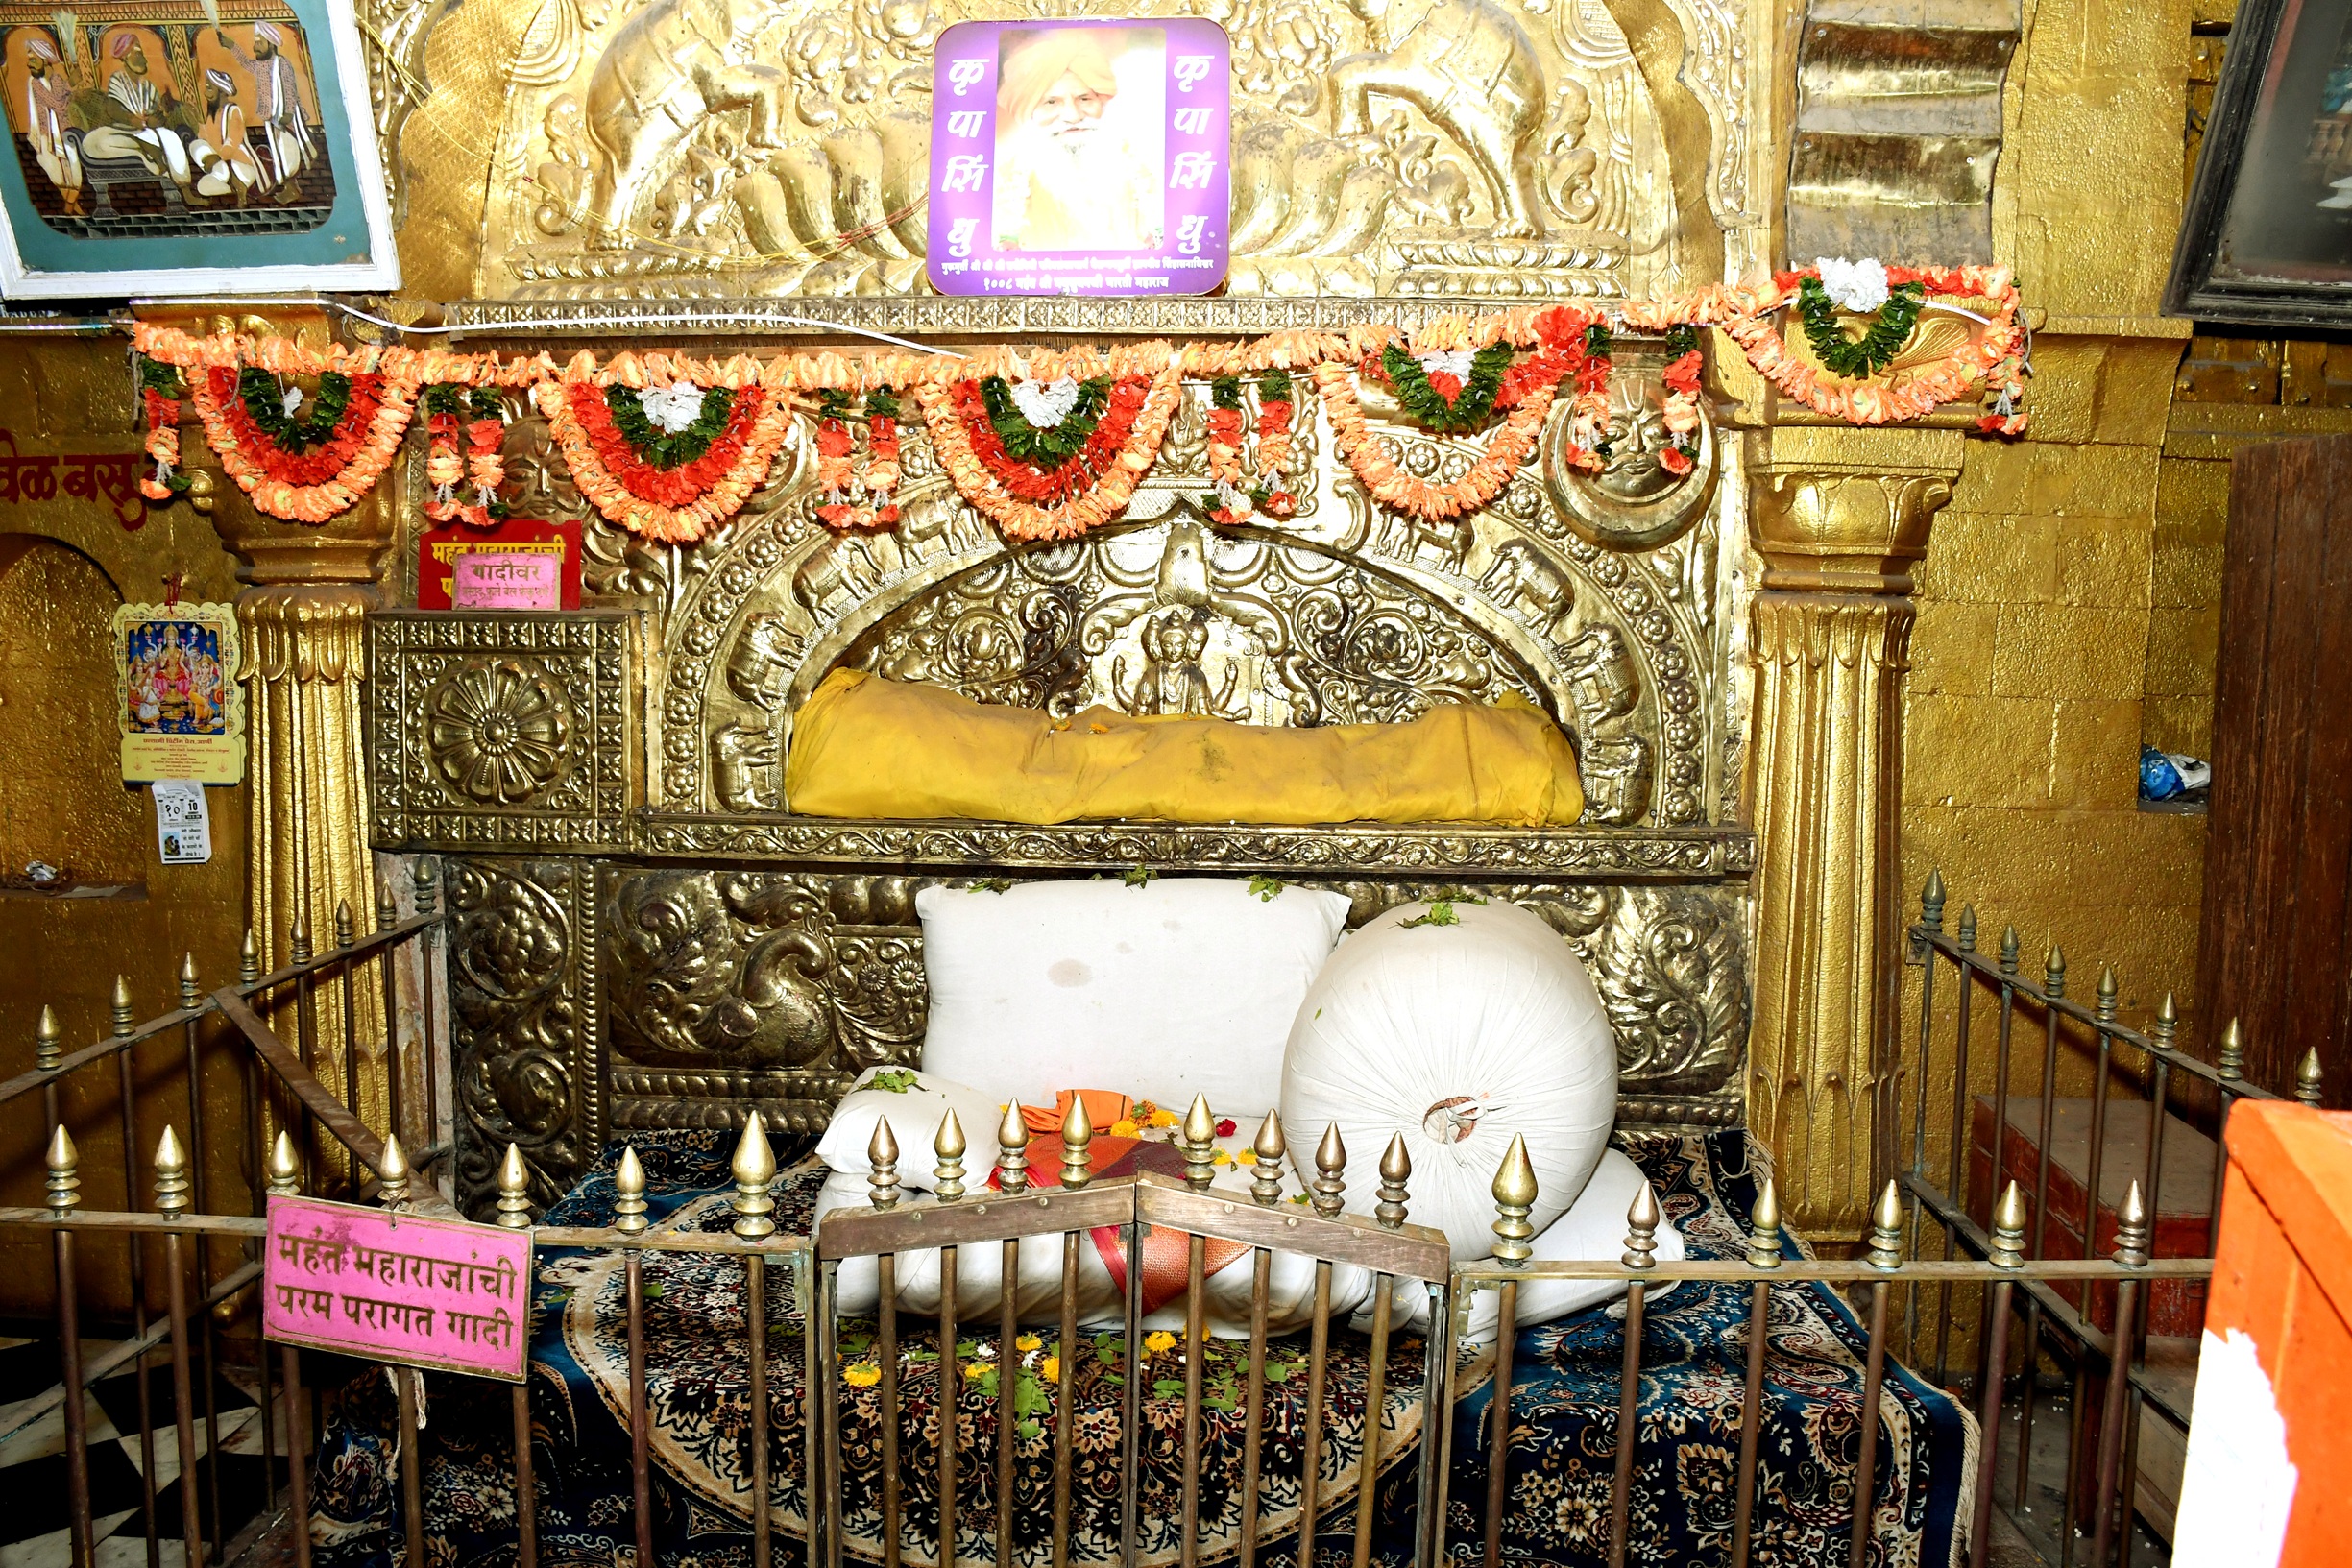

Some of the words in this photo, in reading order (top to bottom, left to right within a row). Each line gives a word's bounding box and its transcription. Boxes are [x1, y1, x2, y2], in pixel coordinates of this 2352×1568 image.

[983, 277, 1013, 291] १००८
[1134, 276, 1169, 289] महाराज
[188, 802, 198, 811] 10
[277, 1225, 344, 1276] महंत
[351, 1247, 518, 1301] महाराजांची
[275, 1284, 334, 1322] परम
[340, 1293, 435, 1338] परागत
[445, 1307, 515, 1352] गादी
